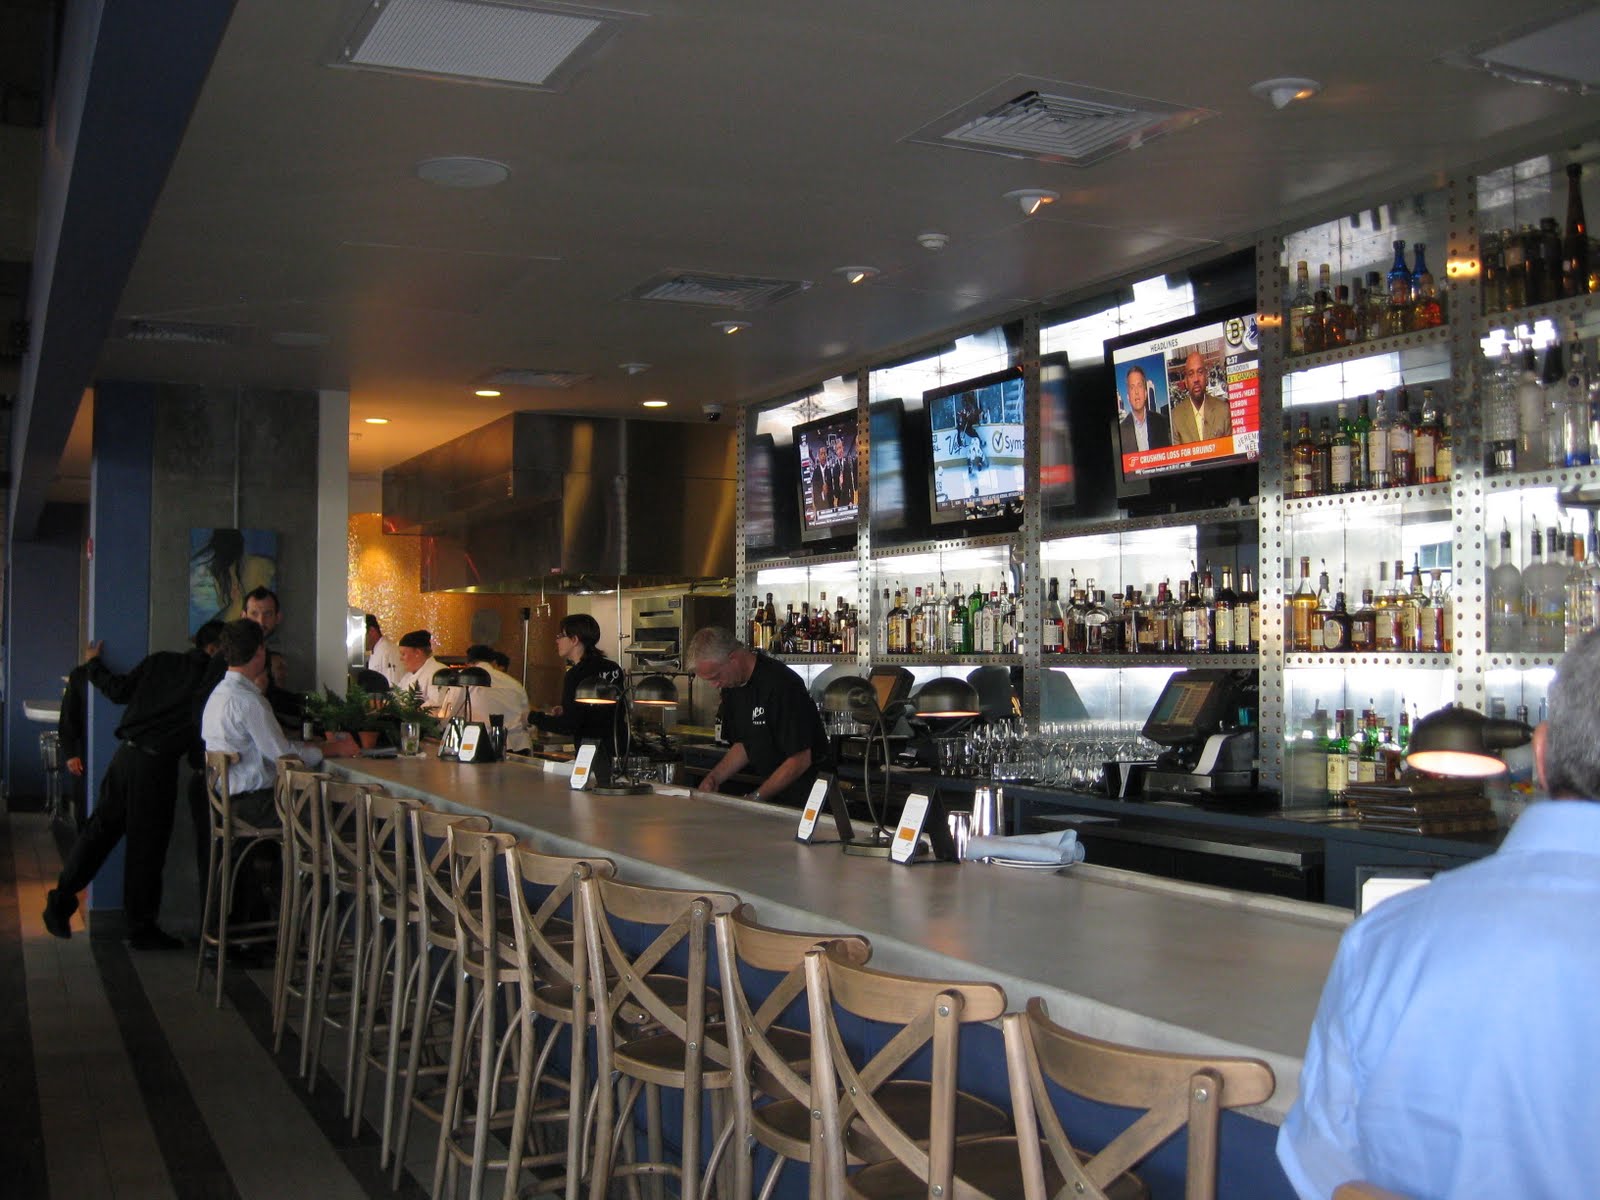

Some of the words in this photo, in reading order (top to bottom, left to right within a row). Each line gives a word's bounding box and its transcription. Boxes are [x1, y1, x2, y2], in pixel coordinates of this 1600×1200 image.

[1150, 338, 1179, 353] HEADLINES
[1140, 452, 1166, 465] CRUSHING
[1167, 450, 1180, 460] LOSS
[1181, 447, 1192, 457] FOR
[1192, 443, 1216, 456] BRUINS?
[1494, 449, 1513, 466] VOX
